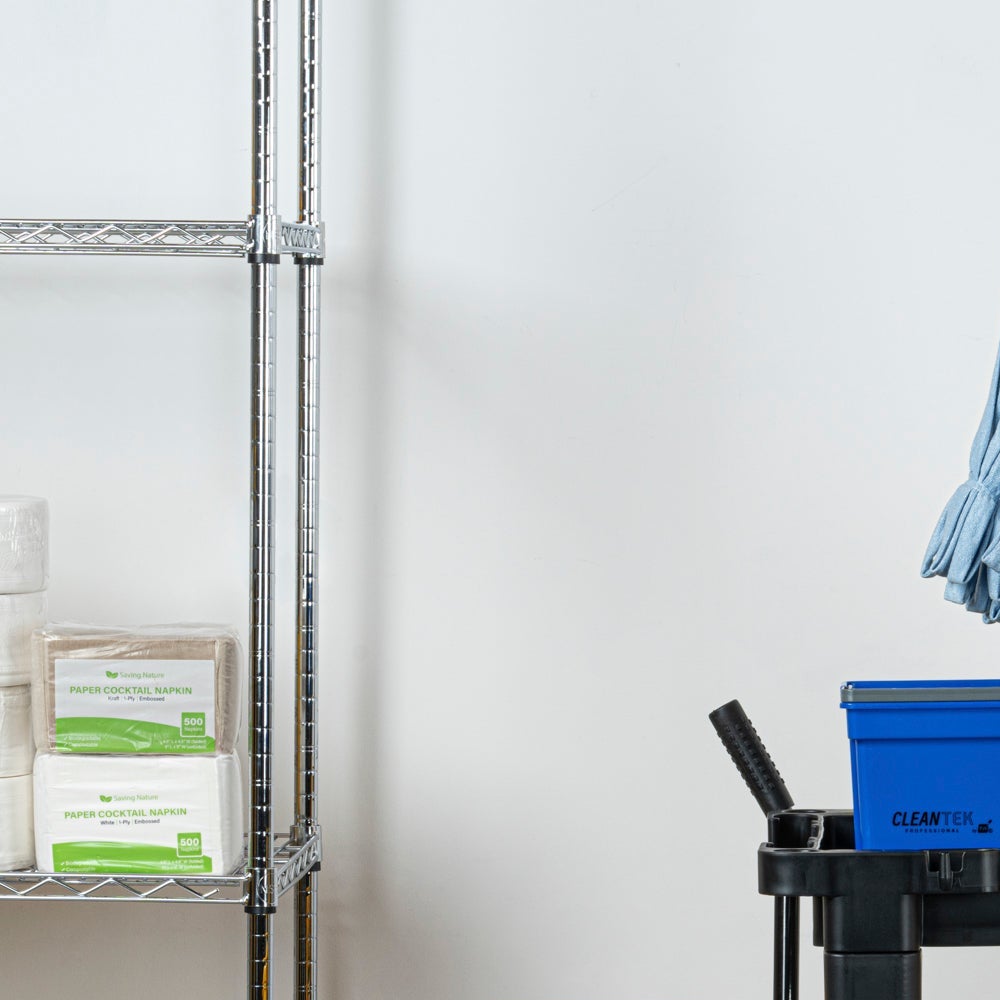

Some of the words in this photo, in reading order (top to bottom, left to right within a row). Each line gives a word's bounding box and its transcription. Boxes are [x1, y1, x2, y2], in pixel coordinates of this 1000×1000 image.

[119, 671, 142, 680] Saving
[142, 671, 165, 679] Nature
[69, 686, 101, 695] PAPER
[103, 686, 153, 695] COCKTAIL
[154, 686, 193, 695] NAPKIN
[184, 717, 203, 726] 500
[113, 794, 136, 803] Saving
[64, 810, 96, 819] PAPER
[98, 809, 147, 818] COCKTAIL
[149, 807, 187, 817] NAPKIN
[892, 811, 974, 827] CLEANTEK
[180, 837, 199, 847] 500
